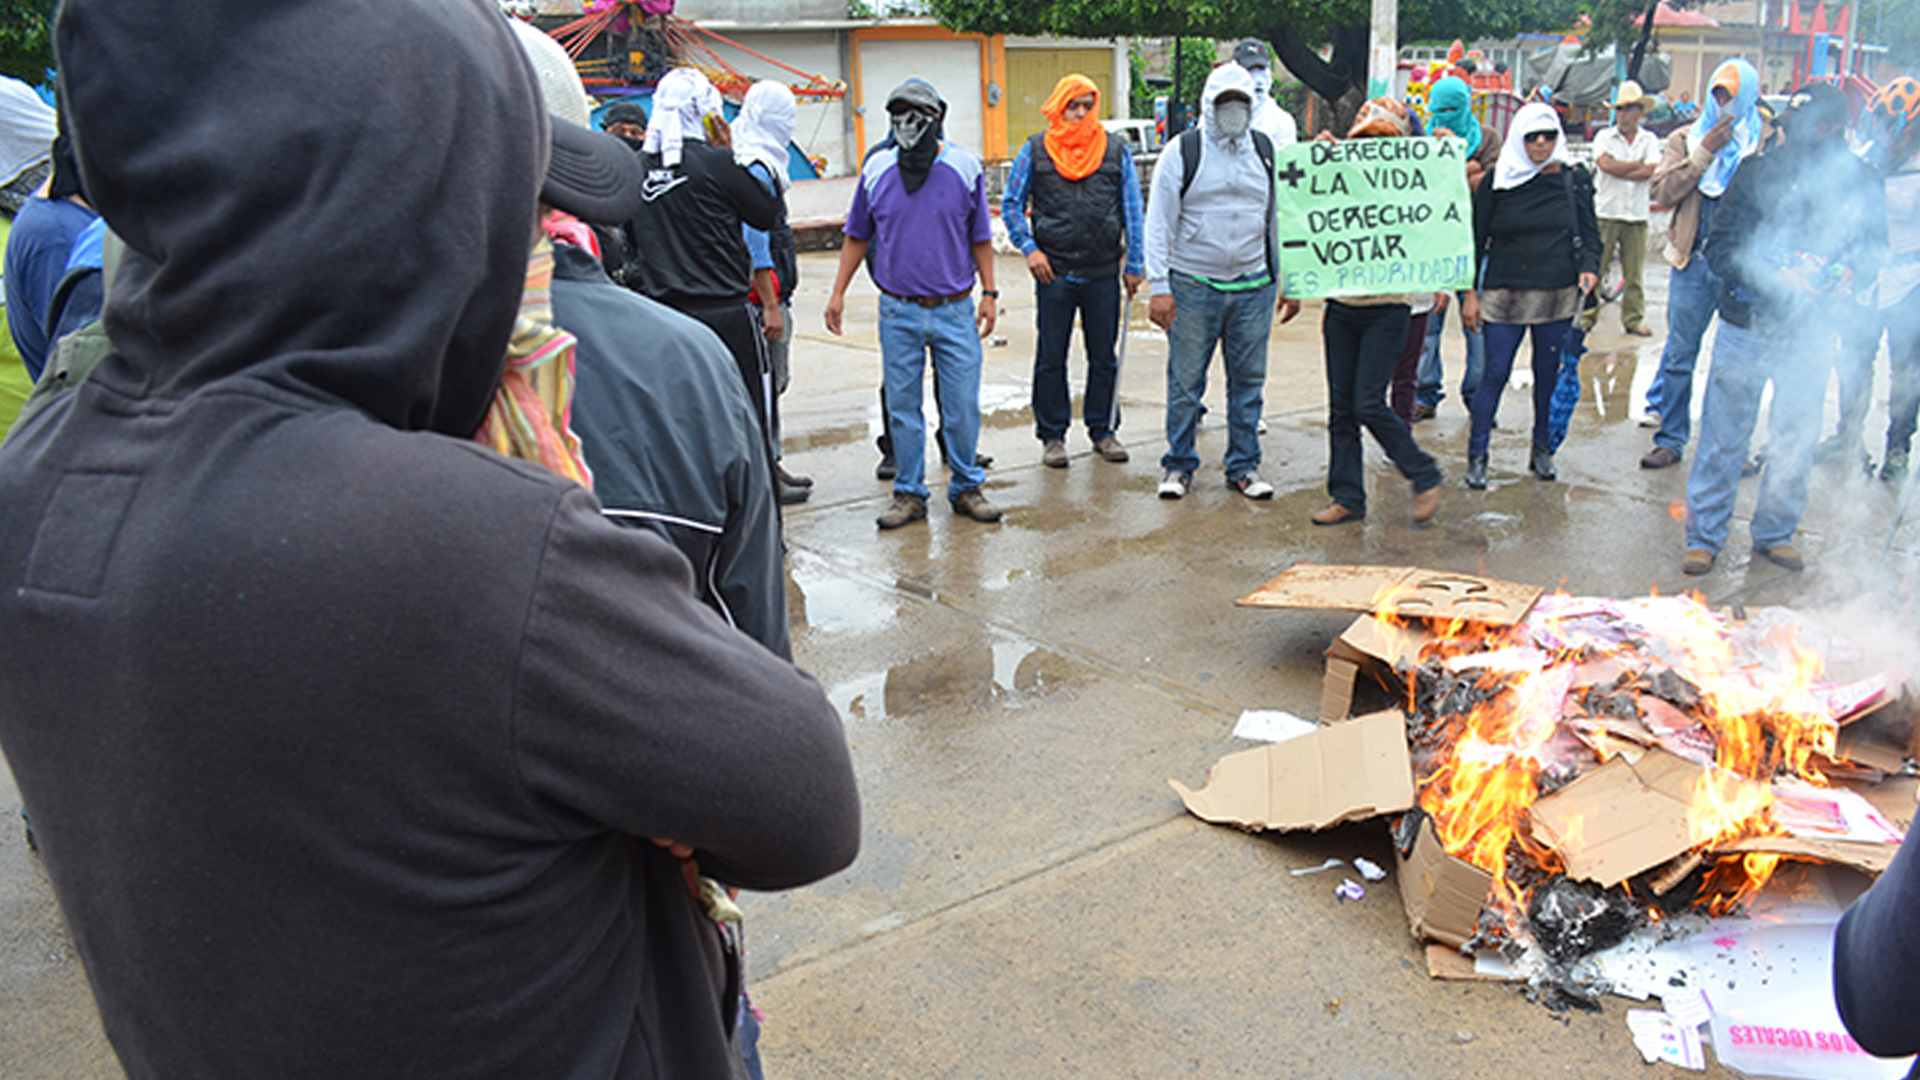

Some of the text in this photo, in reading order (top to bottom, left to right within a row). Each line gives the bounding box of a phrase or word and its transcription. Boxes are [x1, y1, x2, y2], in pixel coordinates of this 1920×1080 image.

[1310, 140, 1456, 166] DERECHO A
[1310, 168, 1428, 195] LA VIDA
[1307, 202, 1462, 234] DERECHO A
[1311, 234, 1407, 266] VOTAR
[1283, 271, 1320, 296] ES
[1729, 1025, 1814, 1049] LOCALES
